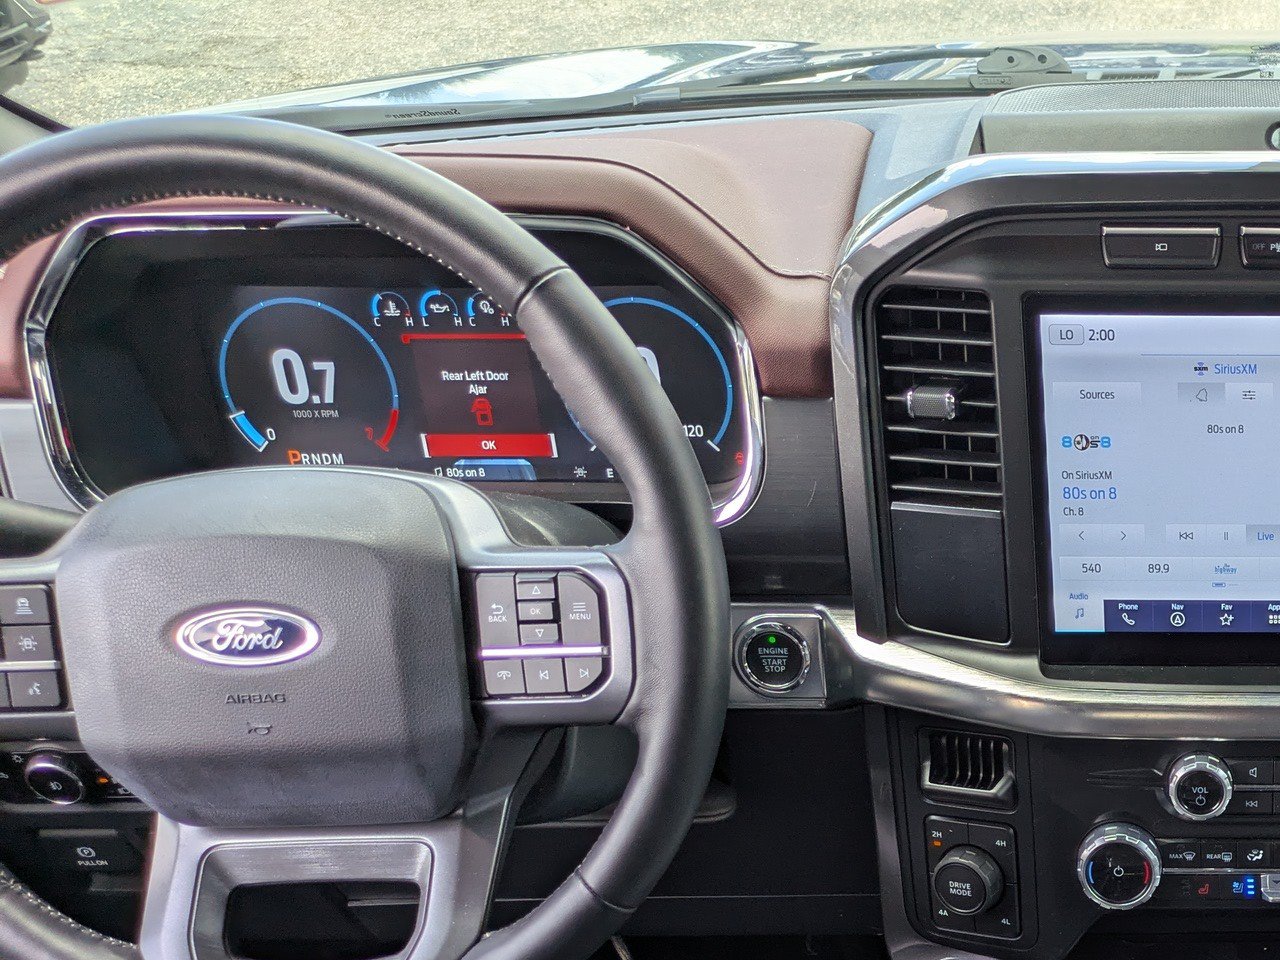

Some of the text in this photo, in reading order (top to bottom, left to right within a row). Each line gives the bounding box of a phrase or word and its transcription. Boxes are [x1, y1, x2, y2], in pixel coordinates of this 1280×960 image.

[373, 317, 381, 327] C
[405, 317, 414, 327] H
[423, 317, 429, 327] L
[455, 317, 463, 327] H
[469, 317, 476, 327] C
[501, 317, 510, 327] H
[1059, 329, 1074, 341] LO
[1088, 329, 1115, 342] 2:00
[1214, 363, 1258, 375] SiriusXM
[271, 348, 336, 405] 0.7
[442, 371, 509, 381] Rear Left Door
[469, 384, 488, 395] Ajar
[1079, 389, 1115, 400] Sources
[292, 409, 340, 418] 1000 X RPM
[266, 428, 276, 440] 0
[364, 427, 374, 441] 7
[682, 425, 704, 437] 120
[1207, 424, 1244, 434] 80s on 8
[481, 440, 497, 450] OK
[446, 467, 486, 477] 80s on 8
[1061, 470, 1113, 480] On SiriusXM
[1062, 486, 1117, 500] 80s on 8
[1063, 507, 1084, 516] Ch. 8
[1257, 531, 1275, 541] Live
[1081, 563, 1102, 574] 540
[1147, 563, 1170, 574] 89.9
[1069, 592, 1089, 600] Audio
[529, 607, 541, 615] OK
[1118, 603, 1139, 611] Phone
[1171, 603, 1184, 611] Nav
[1220, 603, 1233, 611] Fav
[488, 615, 507, 623] BACK
[212, 618, 284, 651] Ford
[758, 647, 789, 655] ENGINE
[764, 665, 786, 673] STOP
[225, 693, 287, 705] AIRBAG
[1191, 786, 1209, 794] VOL
[931, 830, 943, 839] 2H
[995, 839, 1007, 847] 4H
[949, 881, 971, 890] DRIVE
[949, 887, 973, 897] MODE
[938, 909, 949, 917] 4A
